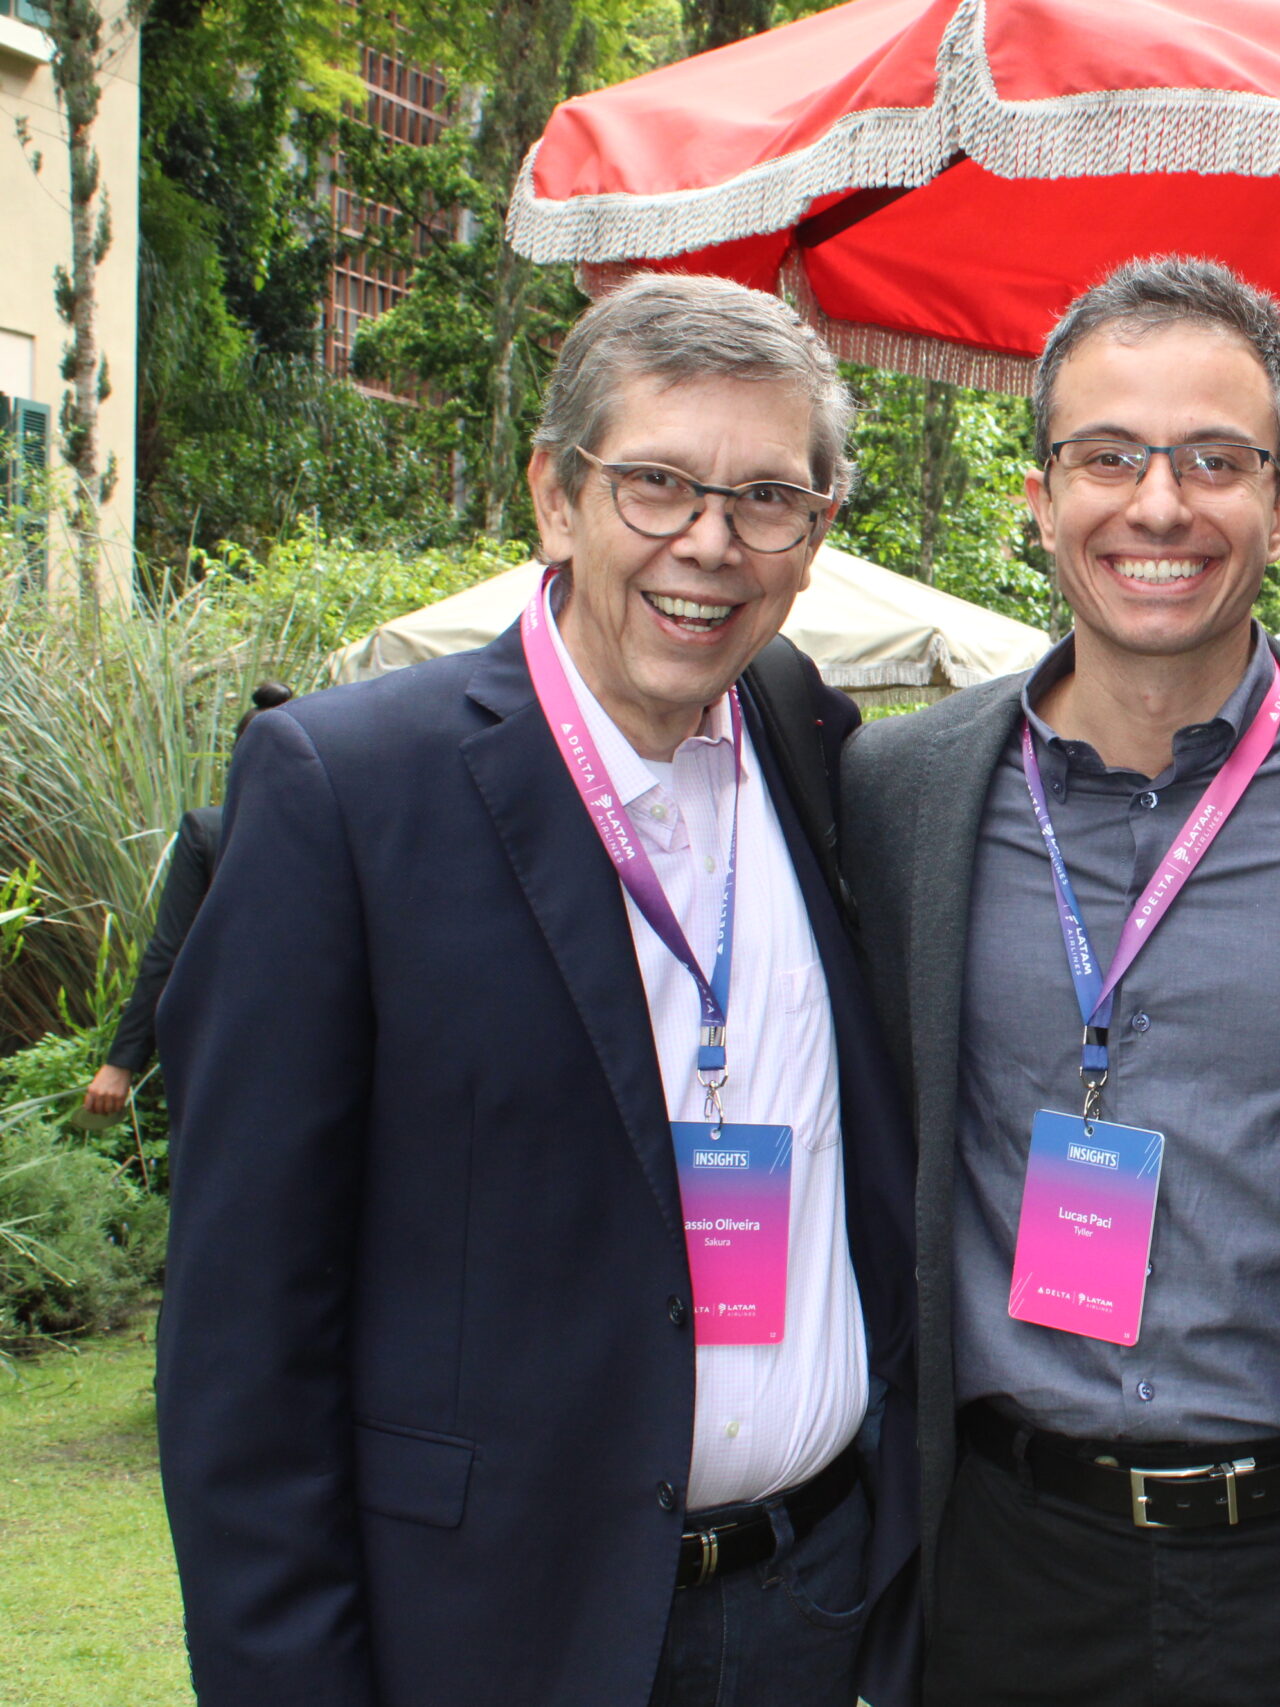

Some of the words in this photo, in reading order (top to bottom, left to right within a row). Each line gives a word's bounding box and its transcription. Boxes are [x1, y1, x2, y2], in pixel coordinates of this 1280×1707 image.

[568, 735, 597, 784] DELTA
[606, 810, 637, 860] LATAM
[596, 815, 625, 865] AIRLINES
[1193, 811, 1224, 854] AIRLINES
[1141, 873, 1175, 906] DELTA
[1183, 804, 1217, 848] LATAM
[1067, 929, 1082, 976] AIRLINES
[1076, 927, 1093, 975] LATAM
[695, 1151, 748, 1167] INSIGHTS
[1069, 1145, 1118, 1168] INSIGHTS
[684, 1218, 714, 1231] assio
[715, 1218, 761, 1231] Oliveira
[1058, 1206, 1089, 1224] Lucas
[1089, 1212, 1113, 1229] Paci
[704, 1237, 732, 1247] Sakura
[1045, 1287, 1071, 1300] DELTA
[1086, 1295, 1113, 1308] LATAM
[694, 1306, 710, 1314] LTA
